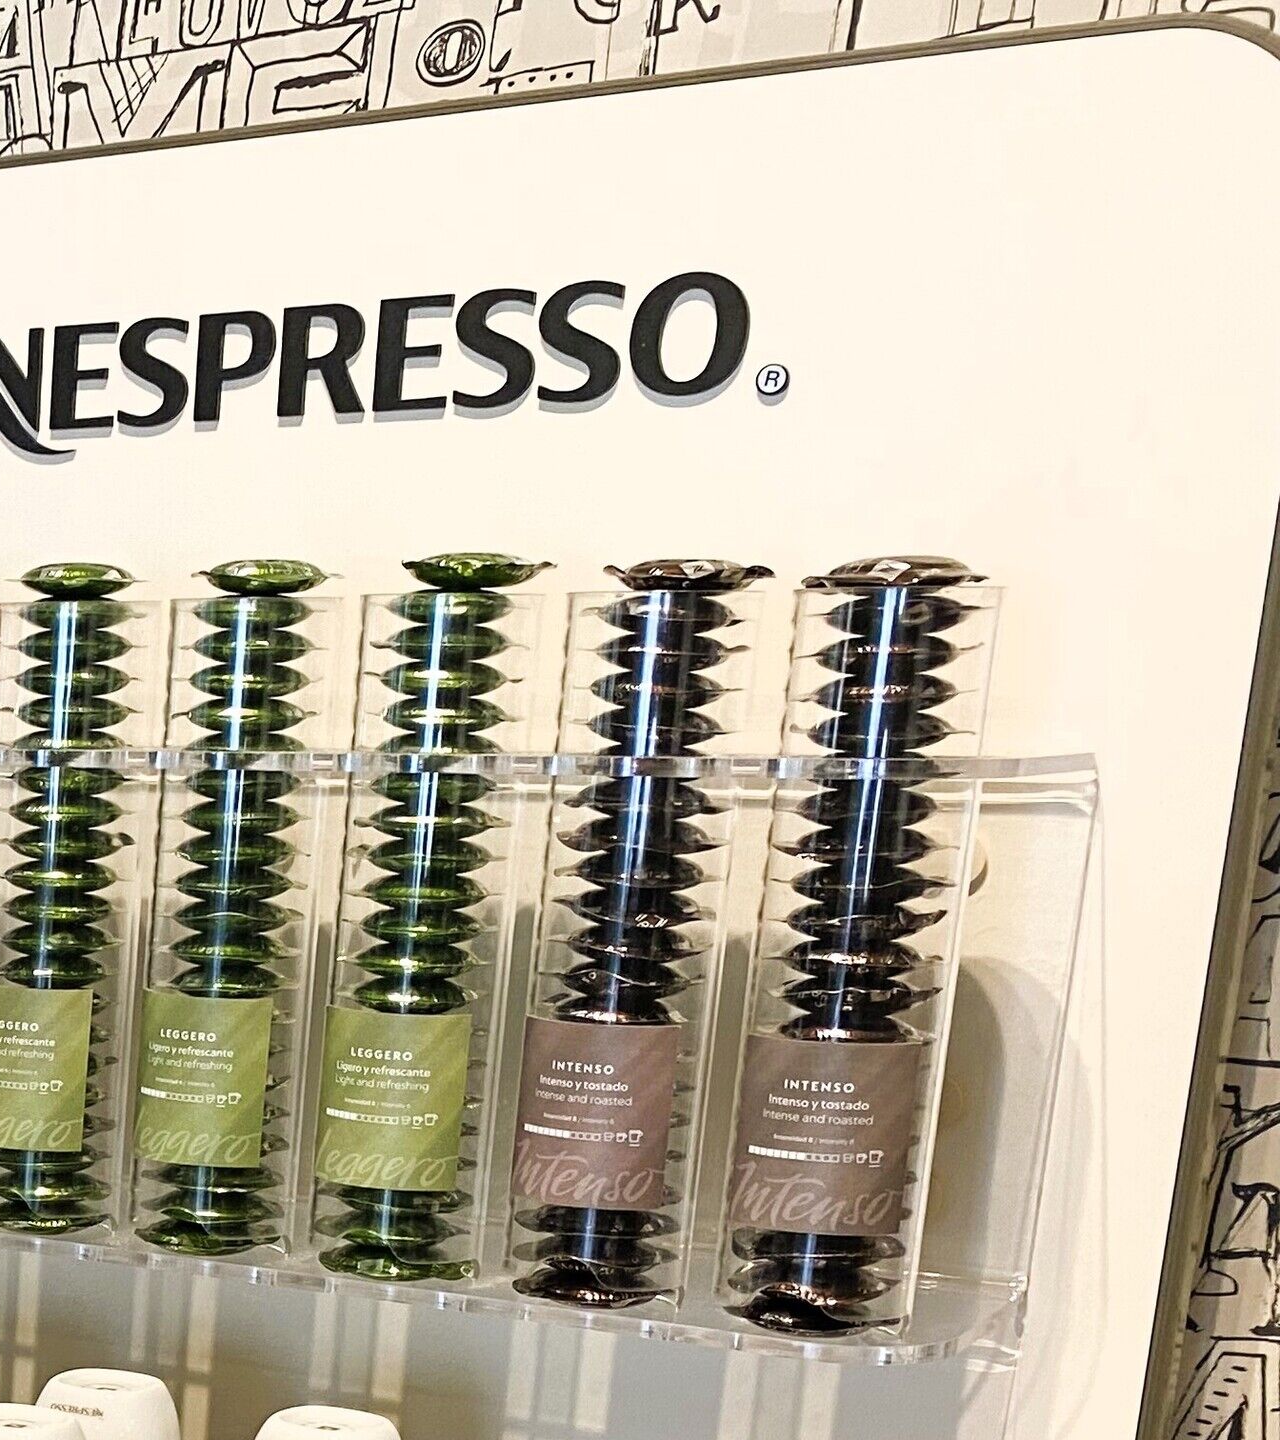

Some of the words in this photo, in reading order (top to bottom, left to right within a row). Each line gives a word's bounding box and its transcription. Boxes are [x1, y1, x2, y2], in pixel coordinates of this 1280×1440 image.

[4, 1035, 56, 1046] refrescante
[160, 1028, 216, 1042] LEGGERO
[178, 1046, 234, 1058] refrescante
[351, 1047, 413, 1061] LEGGERO
[183, 1059, 233, 1073] refreshing
[363, 1067, 370, 1075] y
[371, 1065, 431, 1078] refrescante
[552, 1060, 614, 1075] INTENSO
[356, 1079, 375, 1088] and
[376, 1079, 430, 1093] refreshing
[540, 1074, 573, 1088] Intenso
[575, 1082, 582, 1091] y
[584, 1081, 629, 1092] tostado
[784, 1078, 855, 1094] INTENSO
[567, 1094, 587, 1104] and
[590, 1096, 633, 1106] roasted
[768, 1093, 808, 1108] Intenso
[811, 1101, 819, 1111] y
[821, 1100, 870, 1111] tostado
[762, 1108, 800, 1122] Intense
[802, 1114, 825, 1124] and
[828, 1115, 875, 1126] roasted
